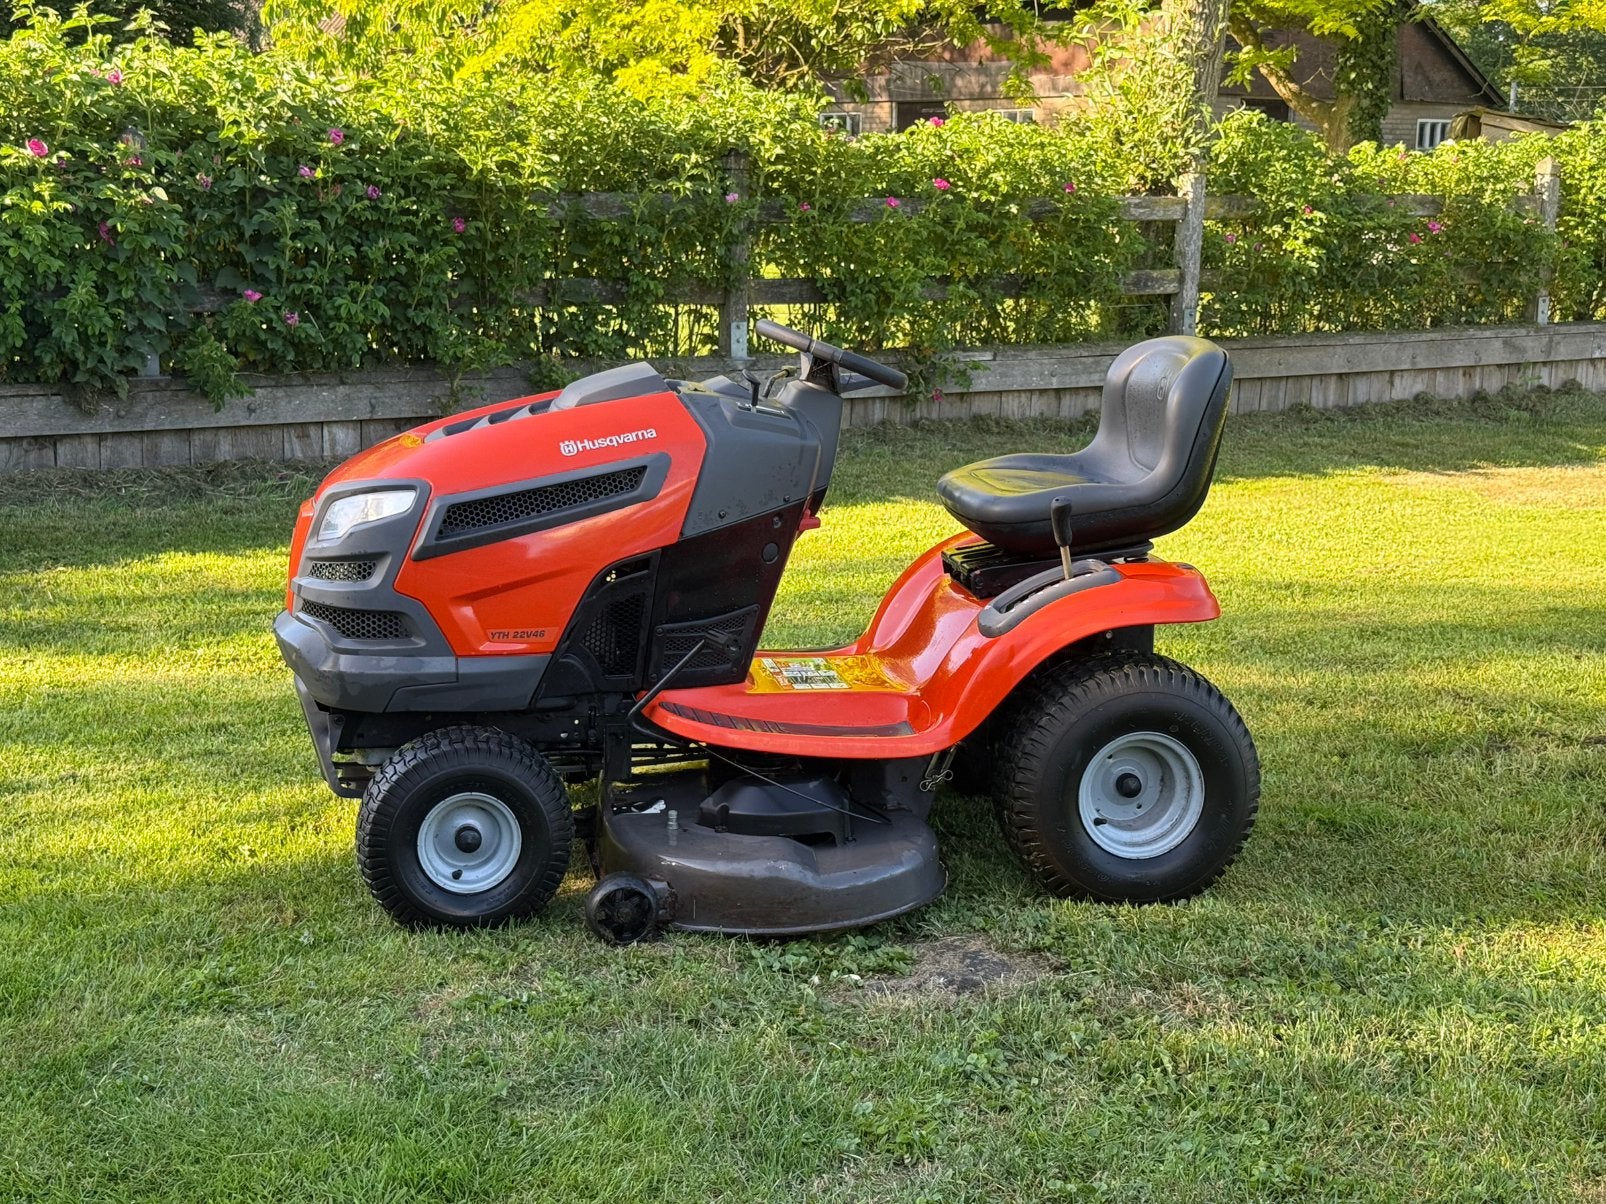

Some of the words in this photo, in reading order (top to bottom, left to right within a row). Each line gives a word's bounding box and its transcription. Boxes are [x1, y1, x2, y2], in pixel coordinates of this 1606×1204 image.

[577, 428, 657, 452] Husqvarna
[490, 631, 509, 640] YTH
[512, 630, 546, 639] 22V46
